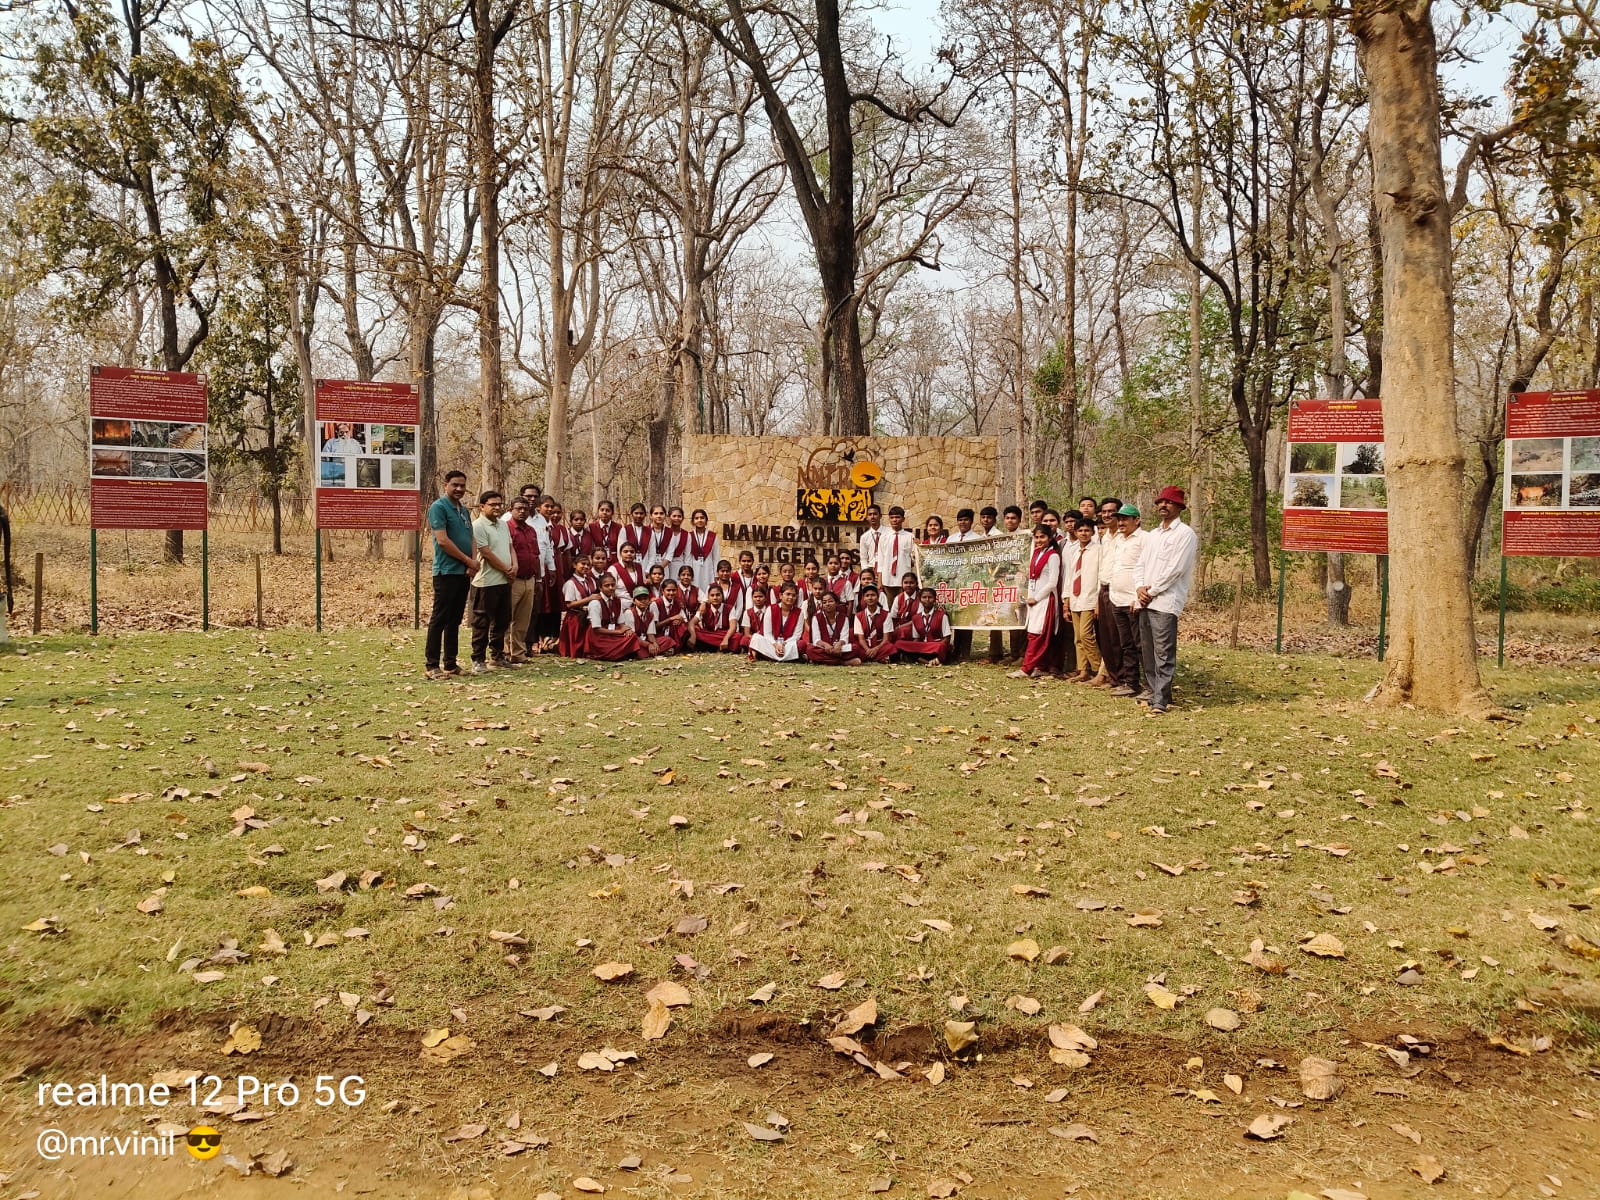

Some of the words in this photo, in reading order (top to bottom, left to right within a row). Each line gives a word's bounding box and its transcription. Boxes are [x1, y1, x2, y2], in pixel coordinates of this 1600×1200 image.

[722, 523, 840, 543] NAWEGAON
[756, 546, 816, 564] TIGER
[959, 581, 988, 607] हरीत
[992, 580, 1018, 605] सेना
